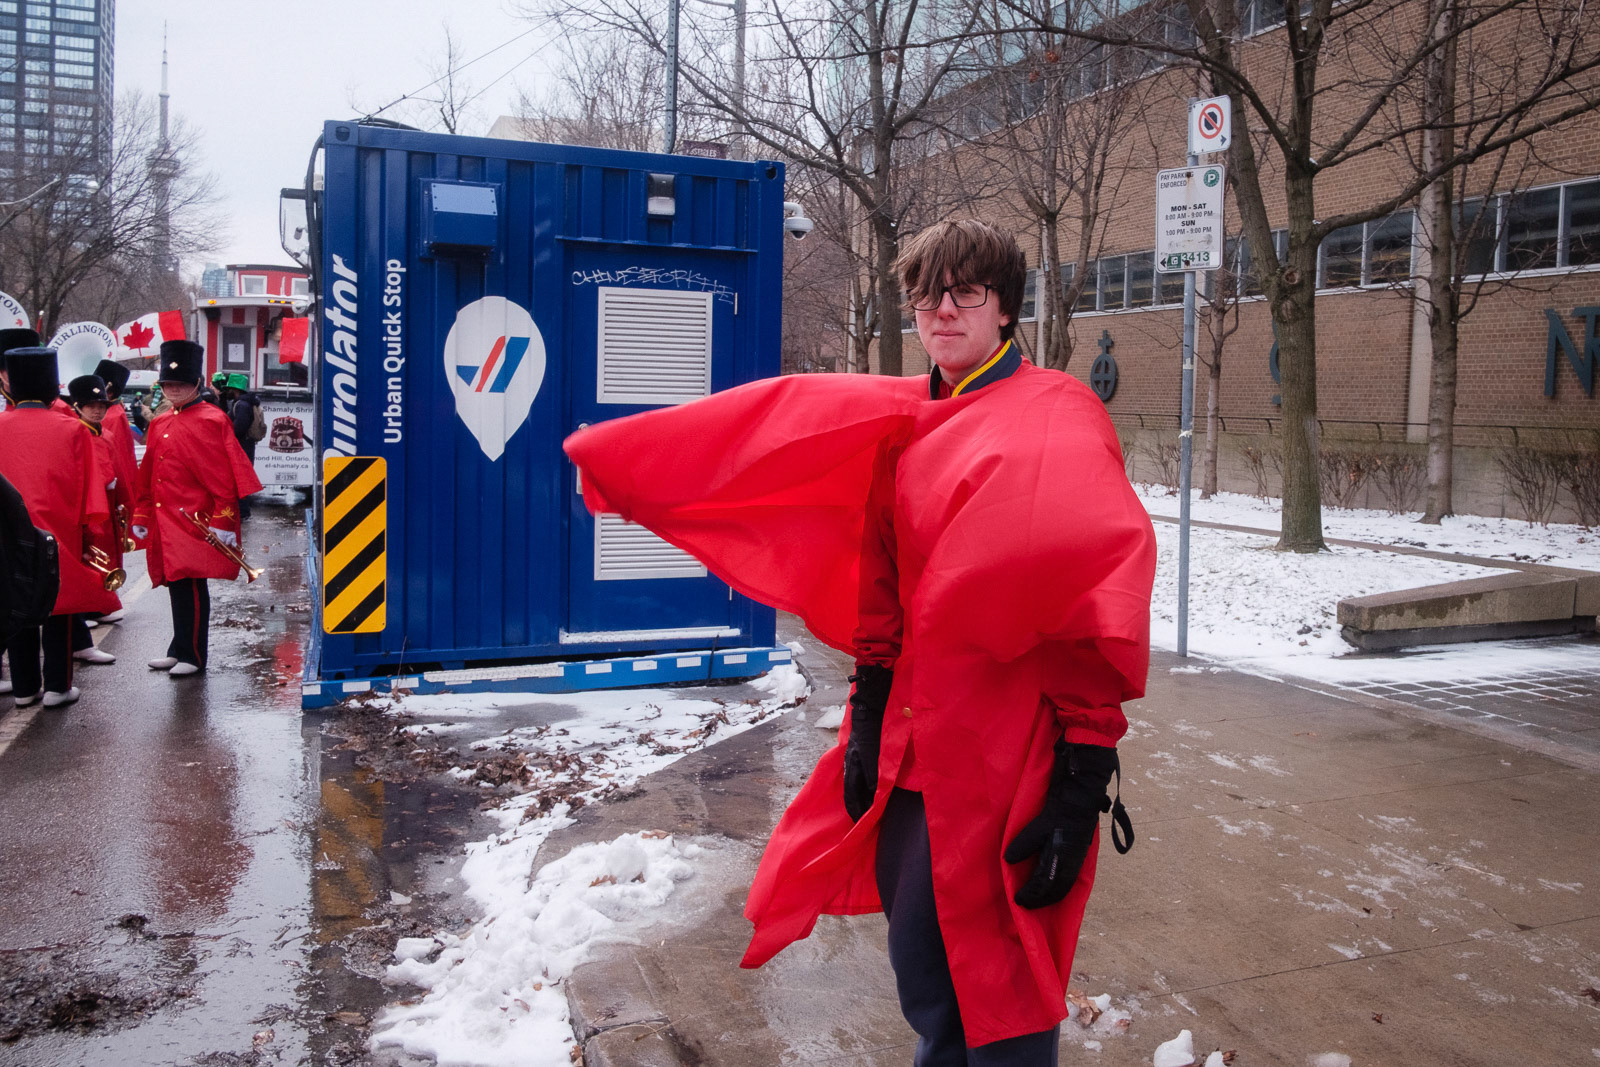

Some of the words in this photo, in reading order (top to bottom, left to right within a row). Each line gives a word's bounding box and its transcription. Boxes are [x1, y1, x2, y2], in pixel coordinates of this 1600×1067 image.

[1160, 173, 1170, 181] PAY
[1170, 171, 1194, 180] PARKIG
[1160, 180, 1188, 189] ENFORCED
[1191, 211, 1203, 219] 9:00
[1190, 227, 1202, 235] 9:00
[1181, 251, 1210, 262] 3413
[382, 258, 407, 307] Stop
[51, 324, 114, 351] BURLINGTON
[382, 311, 406, 373] Quick
[262, 405, 294, 414] Shamaly
[382, 377, 402, 443] Urban
